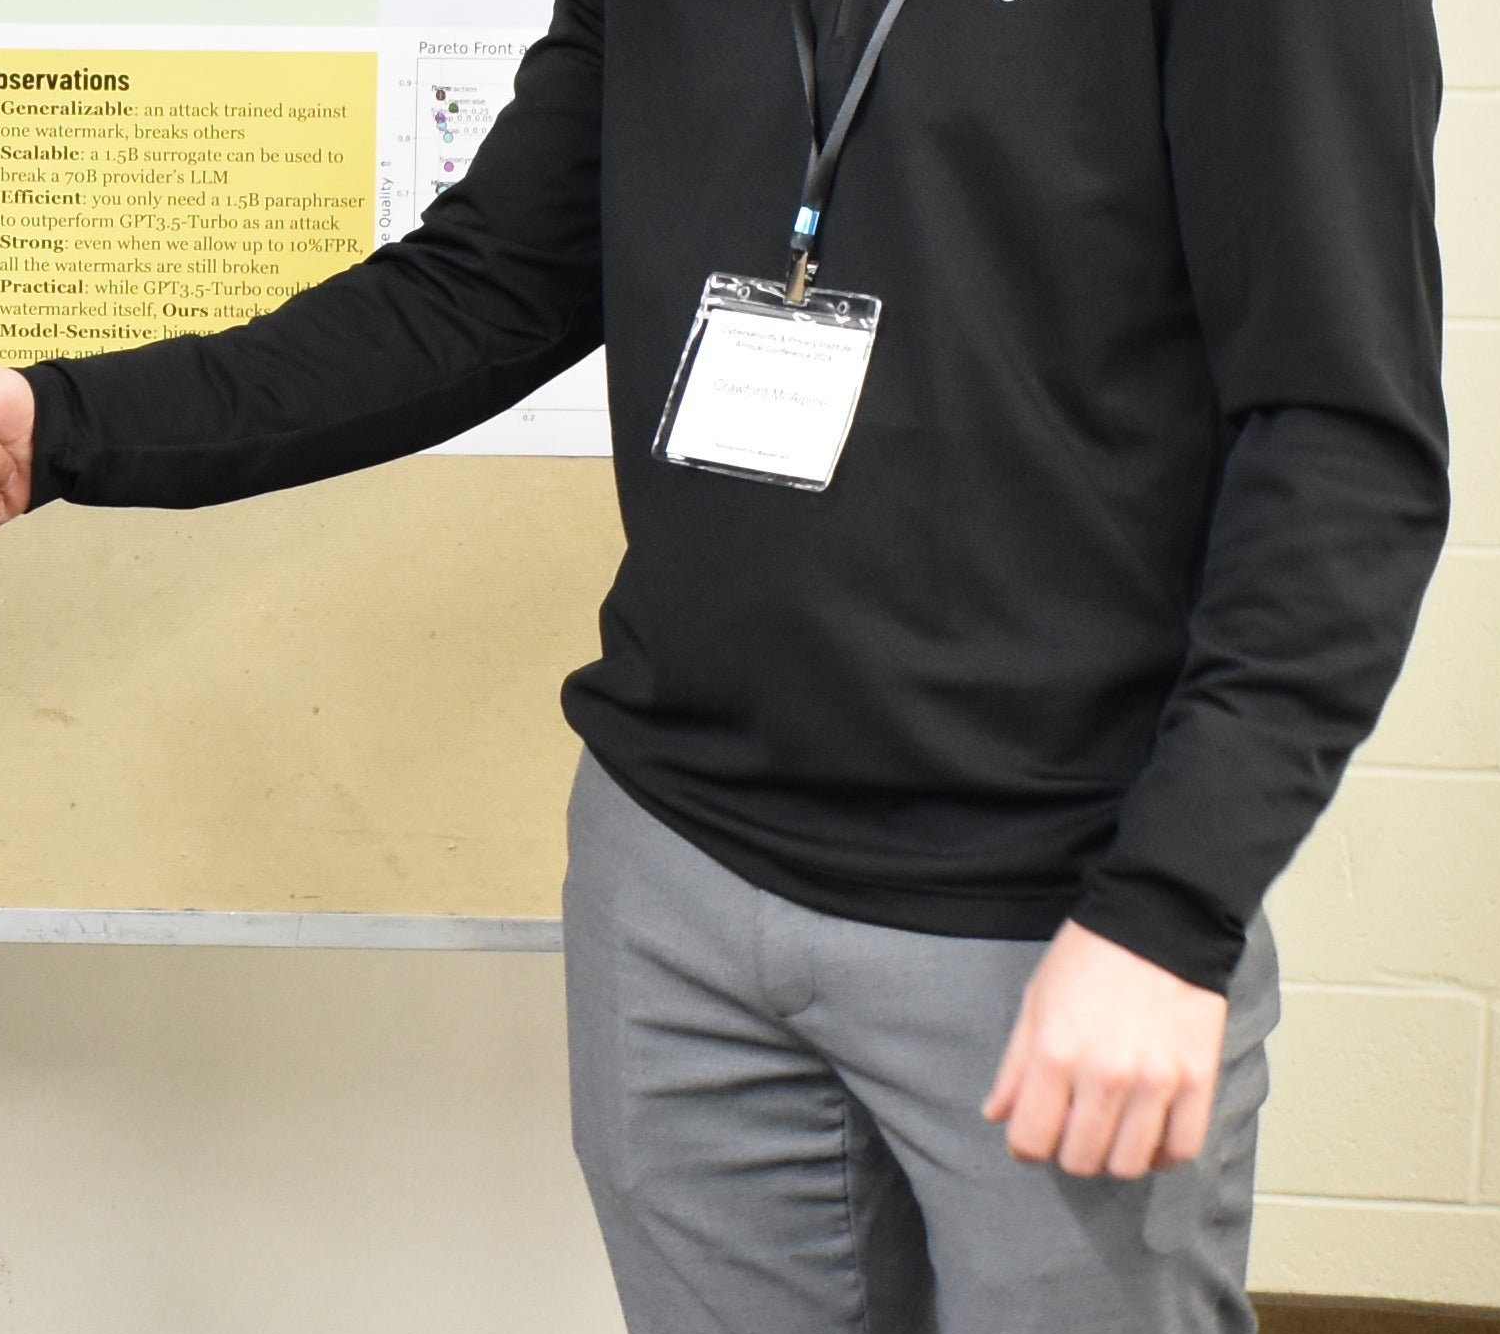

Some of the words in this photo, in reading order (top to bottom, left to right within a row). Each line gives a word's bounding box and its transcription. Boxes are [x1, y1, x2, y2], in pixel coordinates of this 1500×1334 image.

[419, 41, 469, 55] Pareto
[474, 41, 513, 55] Front
[1, 100, 138, 117] Generalizable:
[144, 106, 164, 117] an
[169, 101, 219, 117] attack
[224, 102, 283, 118] trained
[288, 103, 346, 122] against
[0, 126, 30, 138] one
[35, 123, 129, 141] watermark,
[134, 123, 189, 140] breaks
[193, 124, 245, 140] others
[379, 177, 394, 227] Quality
